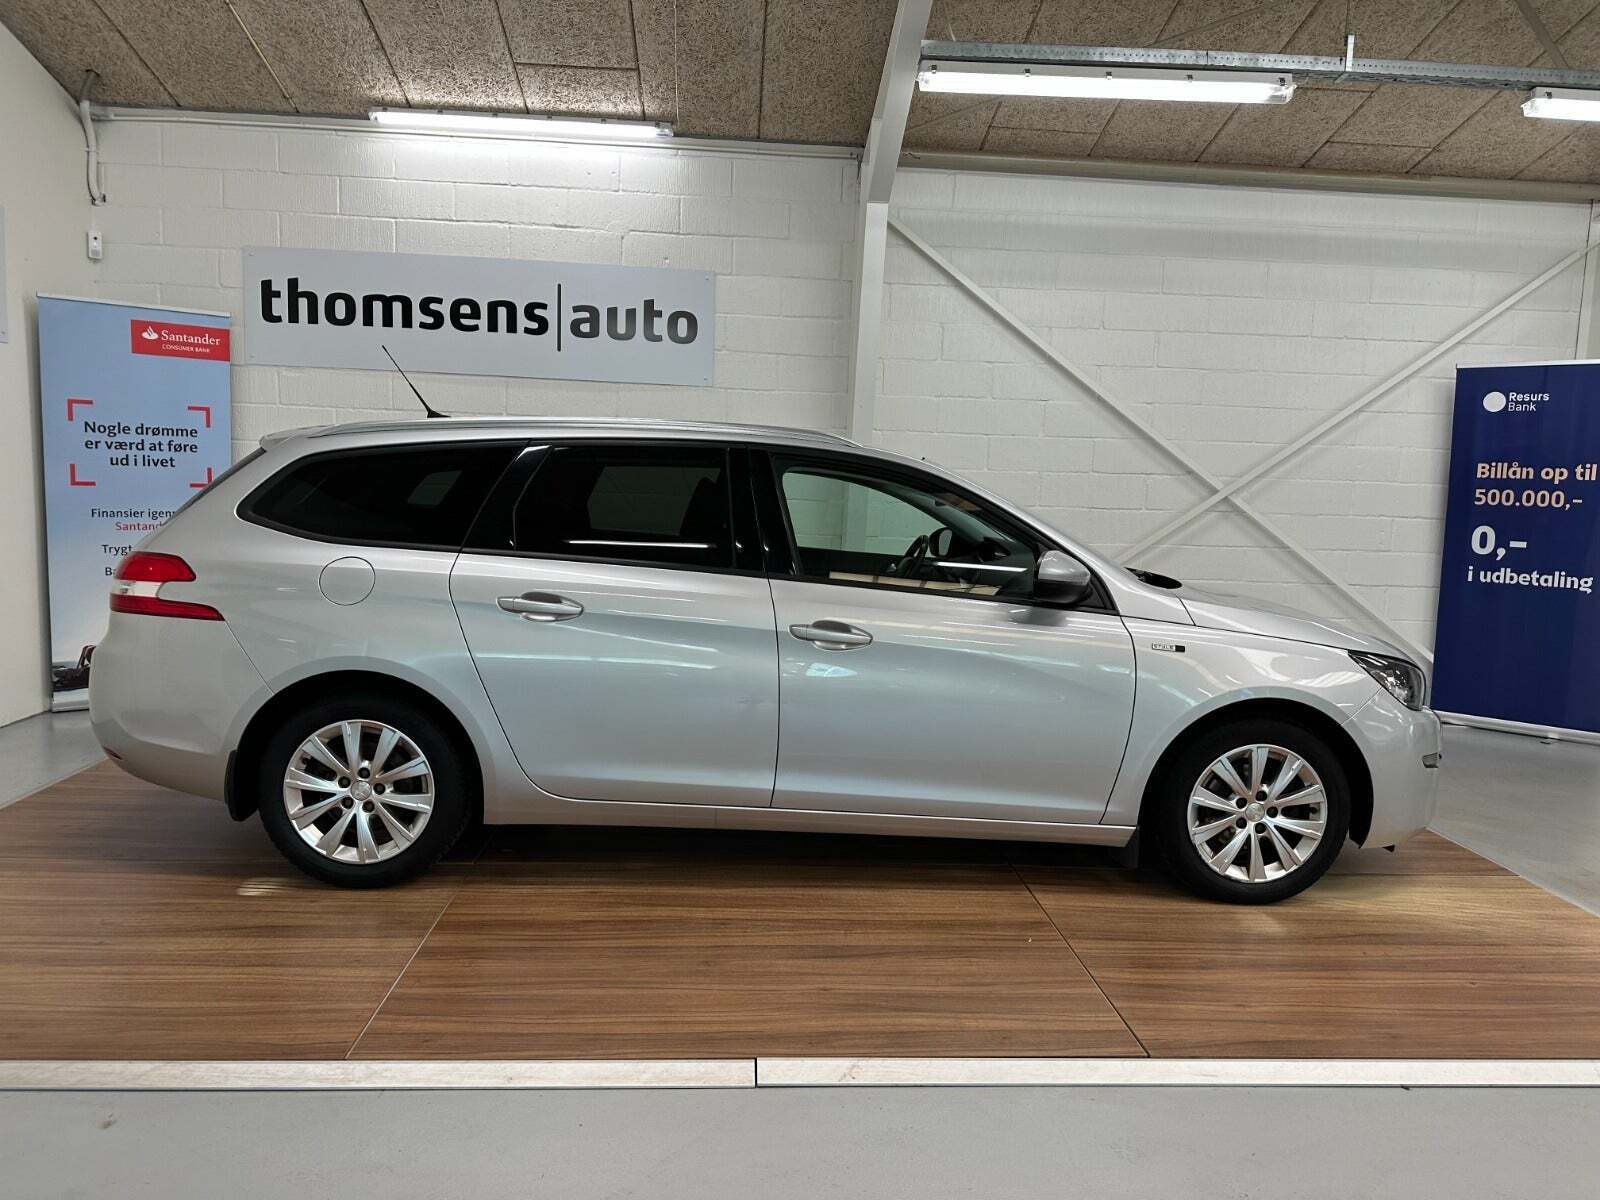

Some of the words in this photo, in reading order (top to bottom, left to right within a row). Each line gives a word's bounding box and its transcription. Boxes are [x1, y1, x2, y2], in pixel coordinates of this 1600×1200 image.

[260, 277, 549, 336] thomsens
[570, 298, 699, 345] auto
[161, 329, 221, 345] Santander
[161, 343, 194, 352] CONSUMER
[1508, 391, 1550, 402] Resurs
[1508, 402, 1537, 412] Bank
[84, 420, 131, 438] Nogle
[135, 423, 198, 438] drømme
[84, 438, 101, 450] er
[105, 438, 145, 452] værd
[149, 440, 163, 452] at
[168, 440, 198, 453] føre
[110, 453, 129, 467] ud
[133, 454, 138, 467] i
[142, 454, 176, 468] livet
[1476, 461, 1534, 480] Billån
[1540, 466, 1569, 484] op
[1575, 463, 1598, 481] til
[1474, 488, 1583, 511] 500.000,-
[91, 508, 144, 518] Finansier
[1471, 525, 1528, 561] 0,-
[1467, 566, 1474, 582] i
[1479, 567, 1594, 594] udbetaling
